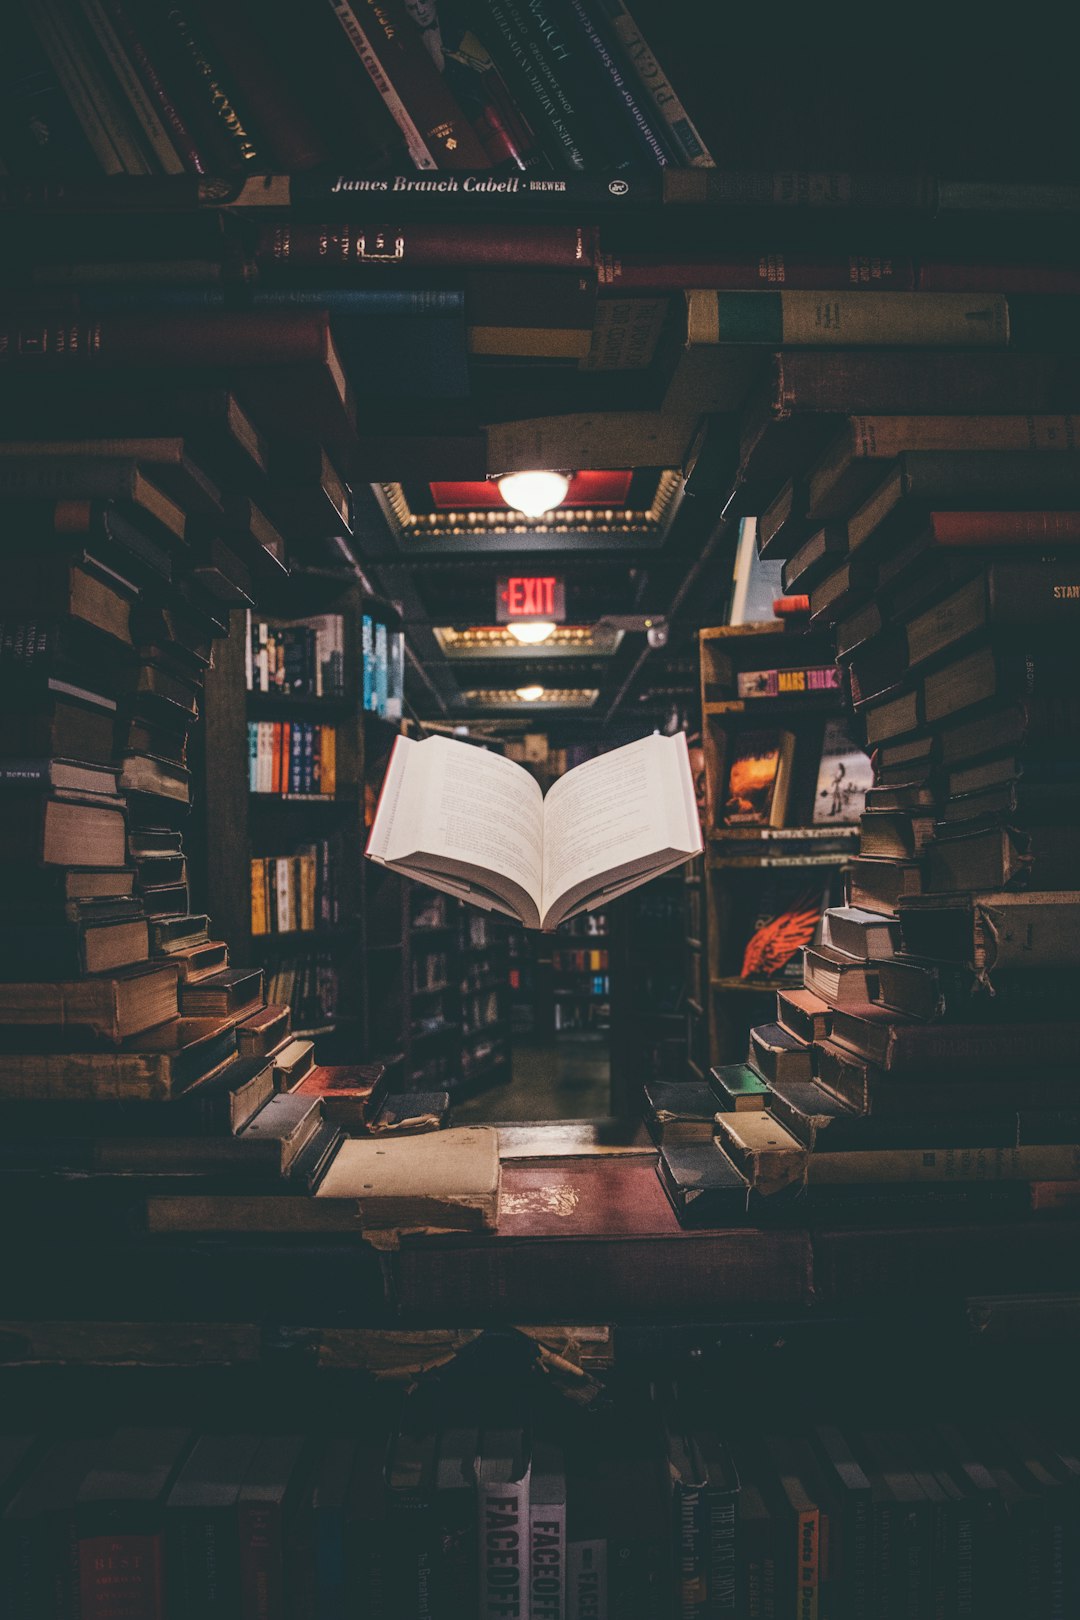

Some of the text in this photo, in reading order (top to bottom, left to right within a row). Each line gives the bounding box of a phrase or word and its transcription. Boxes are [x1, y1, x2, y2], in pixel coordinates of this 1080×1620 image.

[589, 33, 613, 68] Social
[519, 57, 557, 117] AMERICAN
[610, 66, 624, 88] the
[557, 89, 575, 114] JOHN
[620, 88, 634, 108] for
[553, 118, 576, 148] BEST
[632, 105, 669, 168] Simulation
[331, 175, 521, 195] James Branch Cabell
[529, 181, 567, 193] BREWER
[508, 577, 557, 615] EXIT
[37, 633, 48, 652] THE
[778, 671, 805, 692] MARS
[681, 1491, 700, 1552] Murder
[485, 1496, 519, 1620] FACEOFF
[711, 1503, 735, 1609] THE BLACK CABINET
[803, 1519, 815, 1562] Yeats
[534, 1520, 561, 1620] FACEOFF
[682, 1556, 699, 1571] in
[417, 1567, 431, 1615] Greatest
